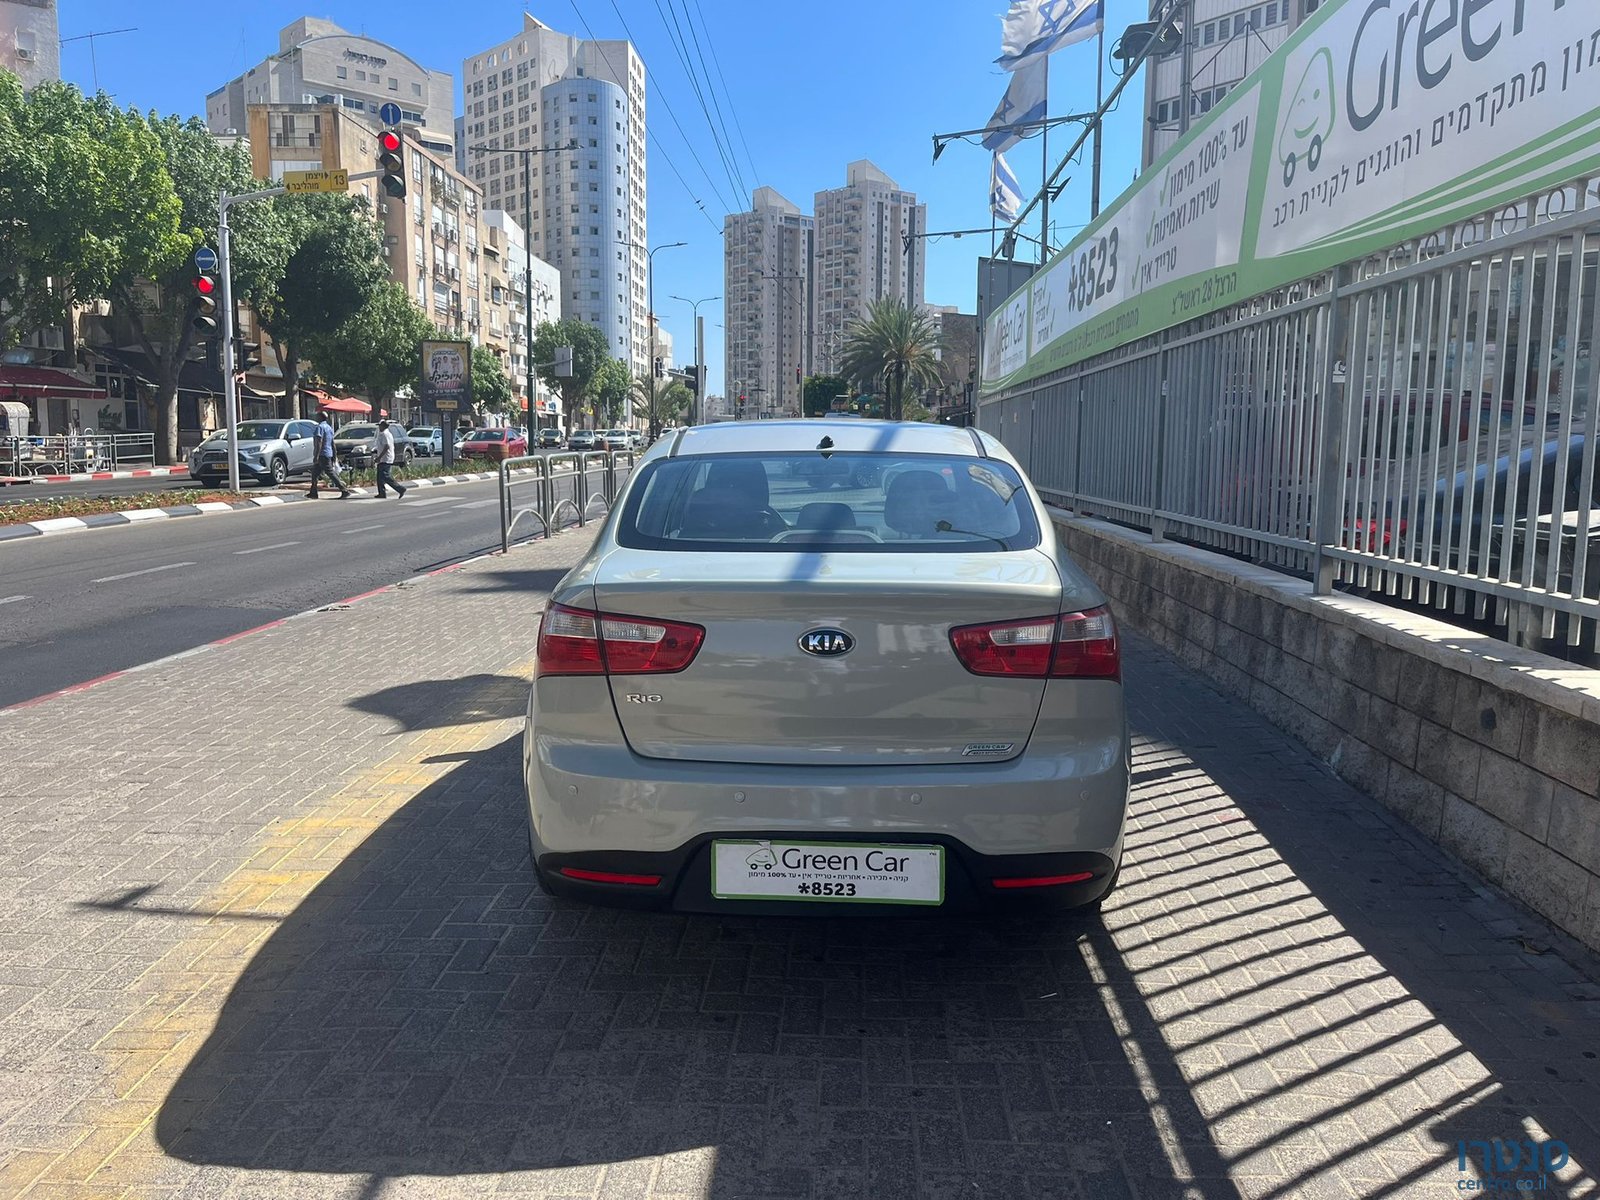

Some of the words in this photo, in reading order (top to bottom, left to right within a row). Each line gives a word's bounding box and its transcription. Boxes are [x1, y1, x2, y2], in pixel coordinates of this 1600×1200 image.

[1346, 0, 1567, 132] Gree
[1431, 60, 1547, 149] מתקדמים
[1232, 116, 1249, 152] עד
[1198, 129, 1227, 178] 100%
[1355, 128, 1422, 186] והוגנים
[305, 172, 324, 182] ויצמן
[333, 174, 345, 186] 13
[1169, 160, 1195, 207] מימון
[1299, 164, 1349, 215] לקניית
[1188, 178, 1221, 222] שירות
[1272, 198, 1294, 228] רכב
[1152, 212, 1186, 247] ואמינות
[1140, 258, 1154, 295] אין
[1155, 246, 1177, 279] טרייד
[1201, 278, 1213, 304] 28
[1215, 271, 1237, 298] הרצל
[808, 635, 846, 650] KIA
[781, 848, 858, 871] Green
[865, 850, 909, 873] Car
